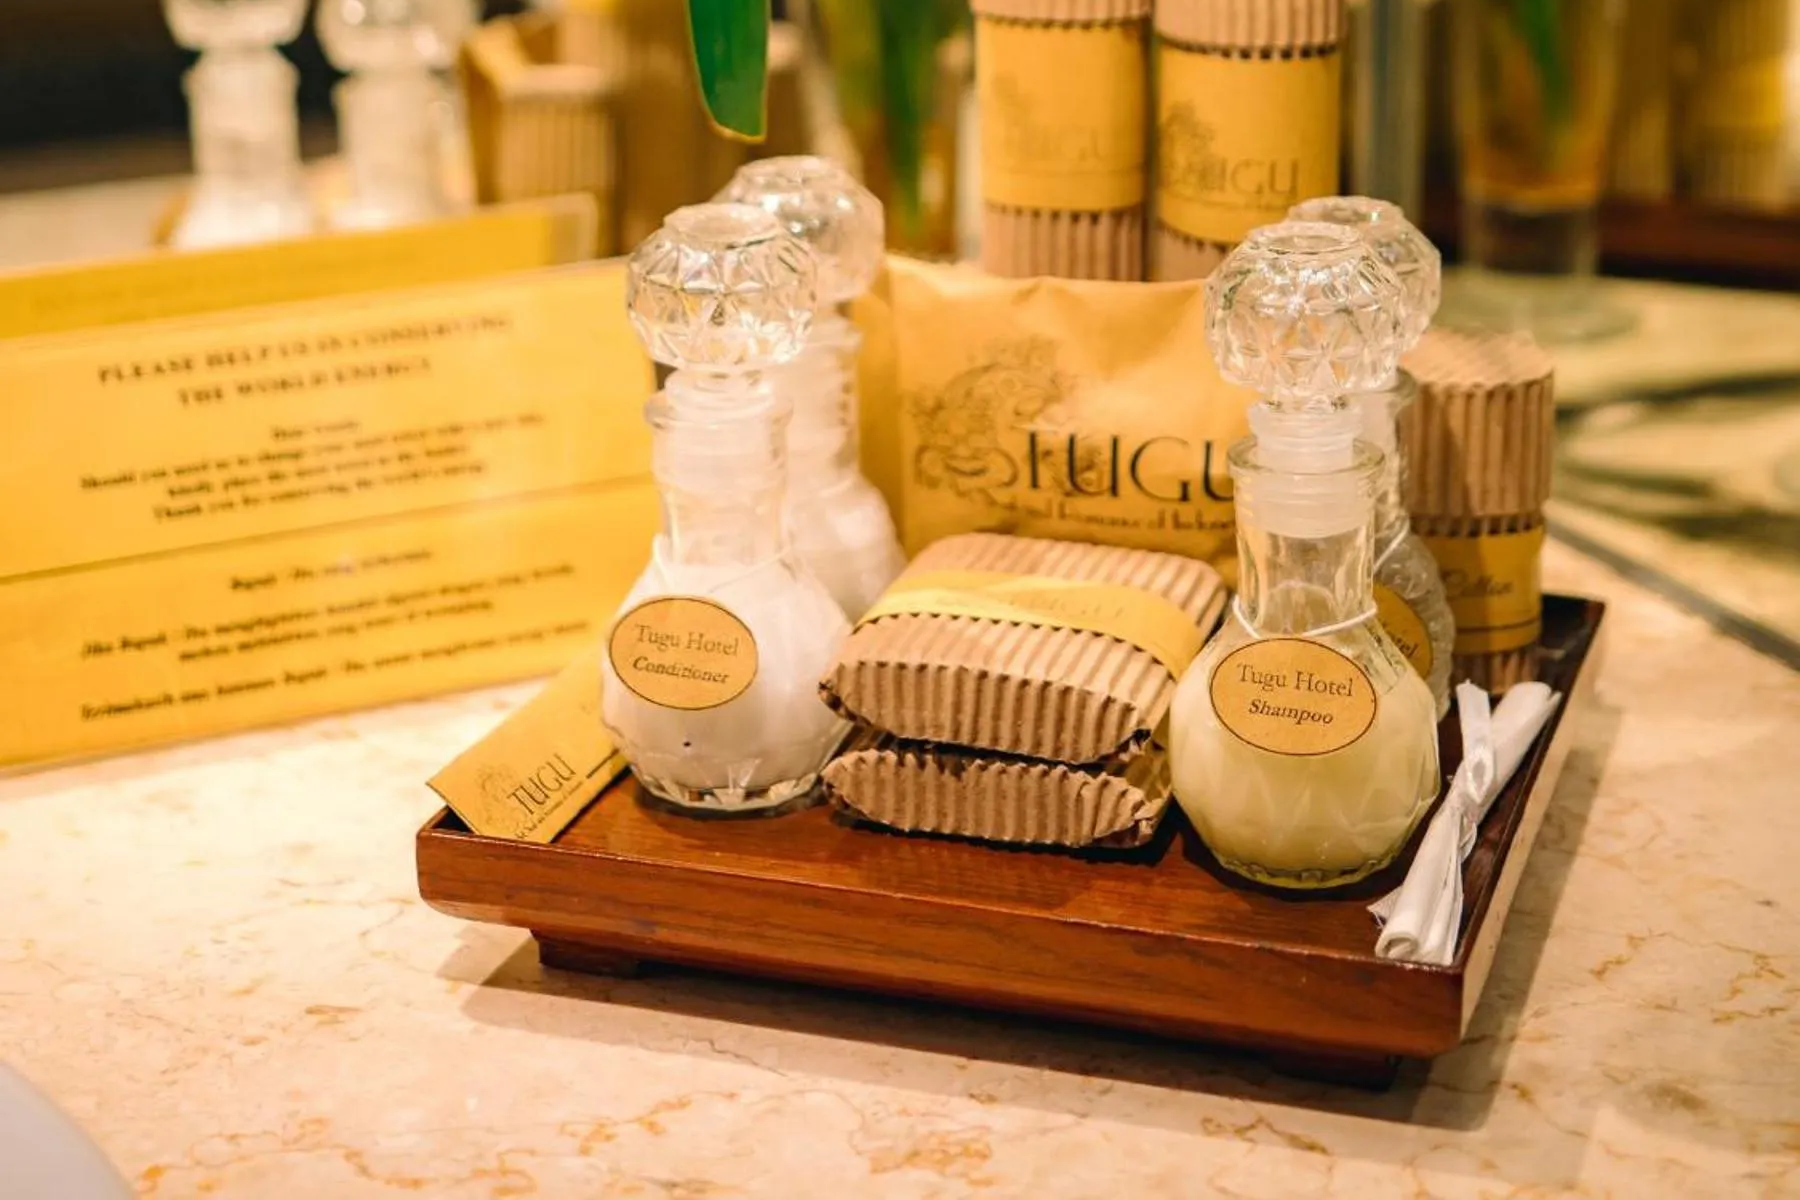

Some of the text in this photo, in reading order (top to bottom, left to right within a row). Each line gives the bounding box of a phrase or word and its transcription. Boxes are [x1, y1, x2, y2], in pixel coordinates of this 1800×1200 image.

[98, 355, 194, 384] PLEASE
[206, 343, 271, 369] HELP
[177, 385, 225, 409] THE
[236, 370, 328, 398] WORLD
[635, 623, 740, 657] Tugu Hotel
[632, 655, 730, 684] Conditioner
[1236, 663, 1354, 697] Tugu Hotel
[1248, 698, 1334, 725] Shampoo
[507, 752, 577, 816] TUGU
